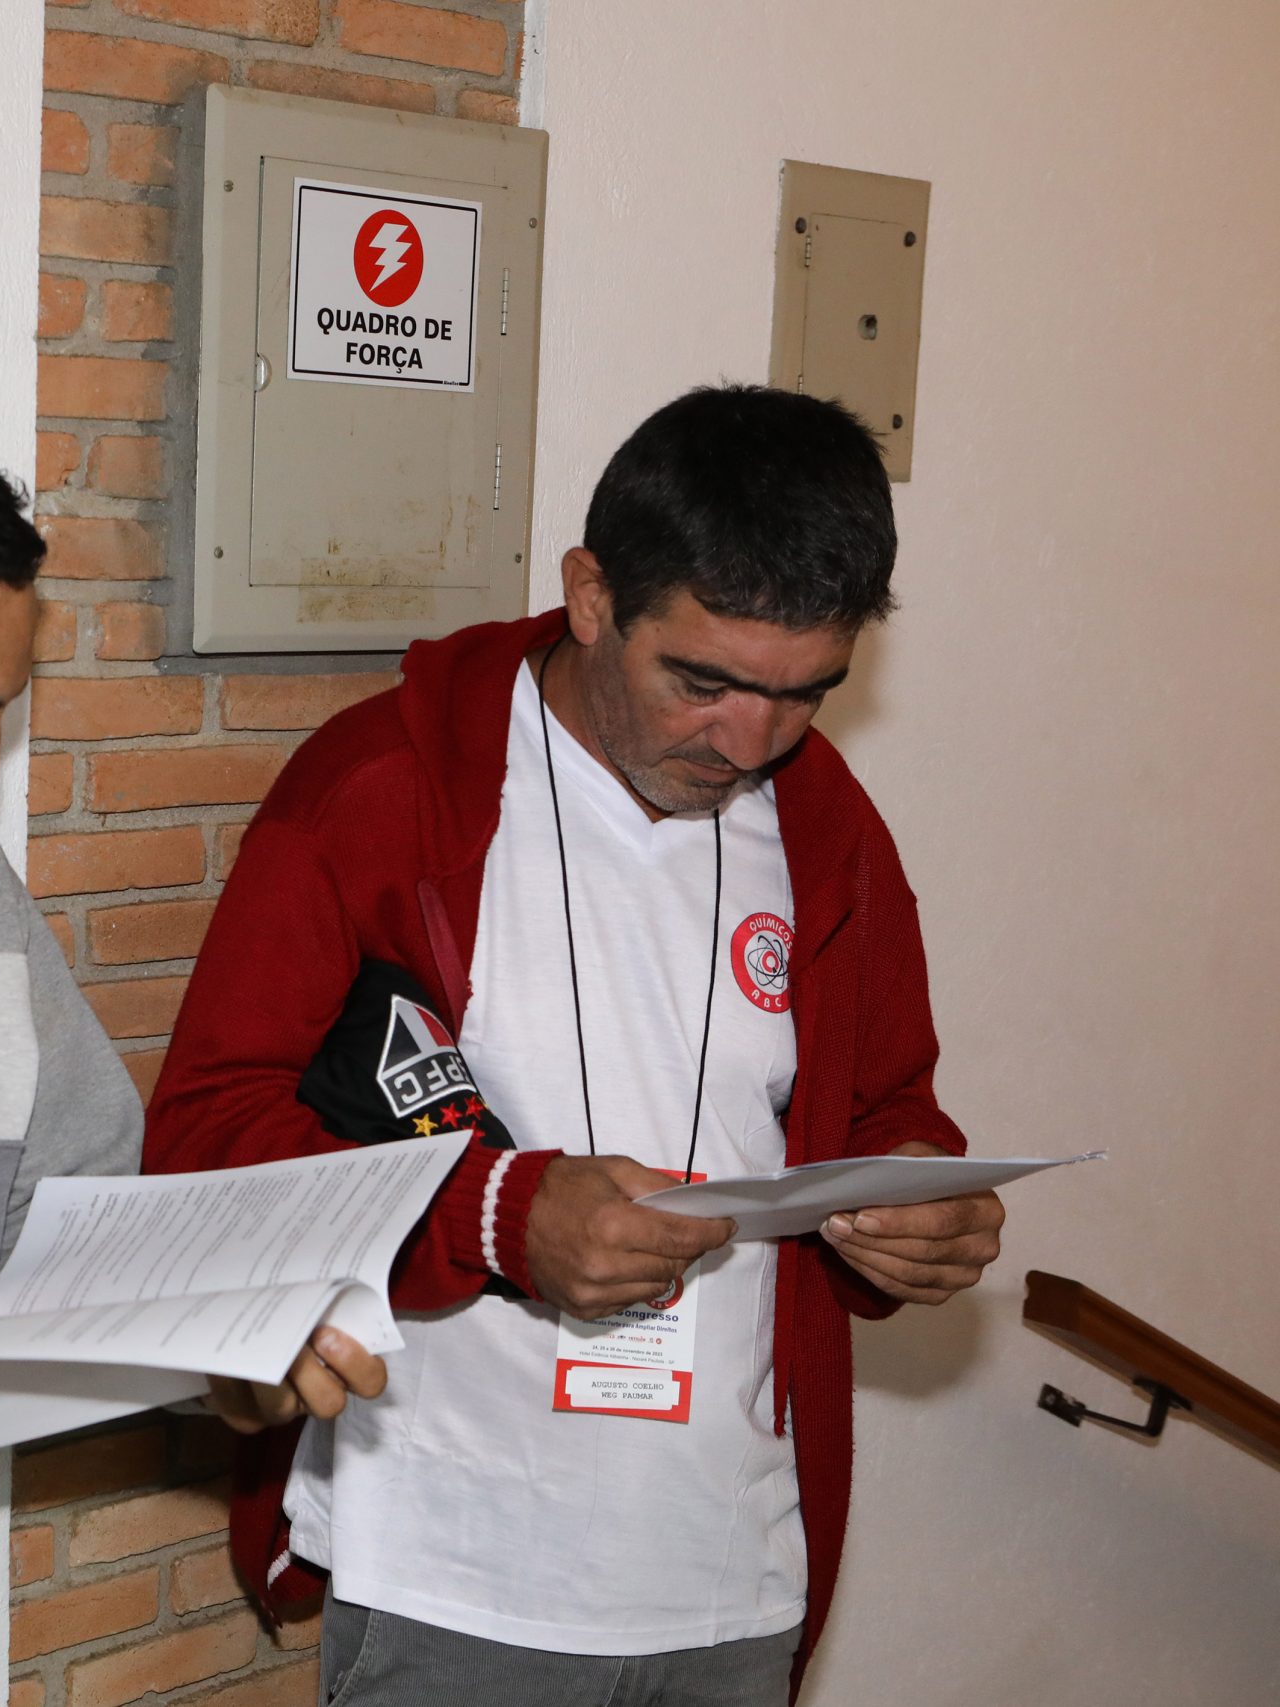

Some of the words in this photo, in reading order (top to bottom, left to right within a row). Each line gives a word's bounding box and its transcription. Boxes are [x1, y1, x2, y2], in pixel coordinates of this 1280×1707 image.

[317, 307, 417, 338] QUADRO
[424, 318, 453, 341] DE
[346, 341, 423, 374] FORÇA
[749, 914, 793, 950] QUÍMICOS
[591, 1381, 628, 1389] AUGUSTO
[632, 1382, 664, 1391] COELHO
[601, 1391, 618, 1399] WEG
